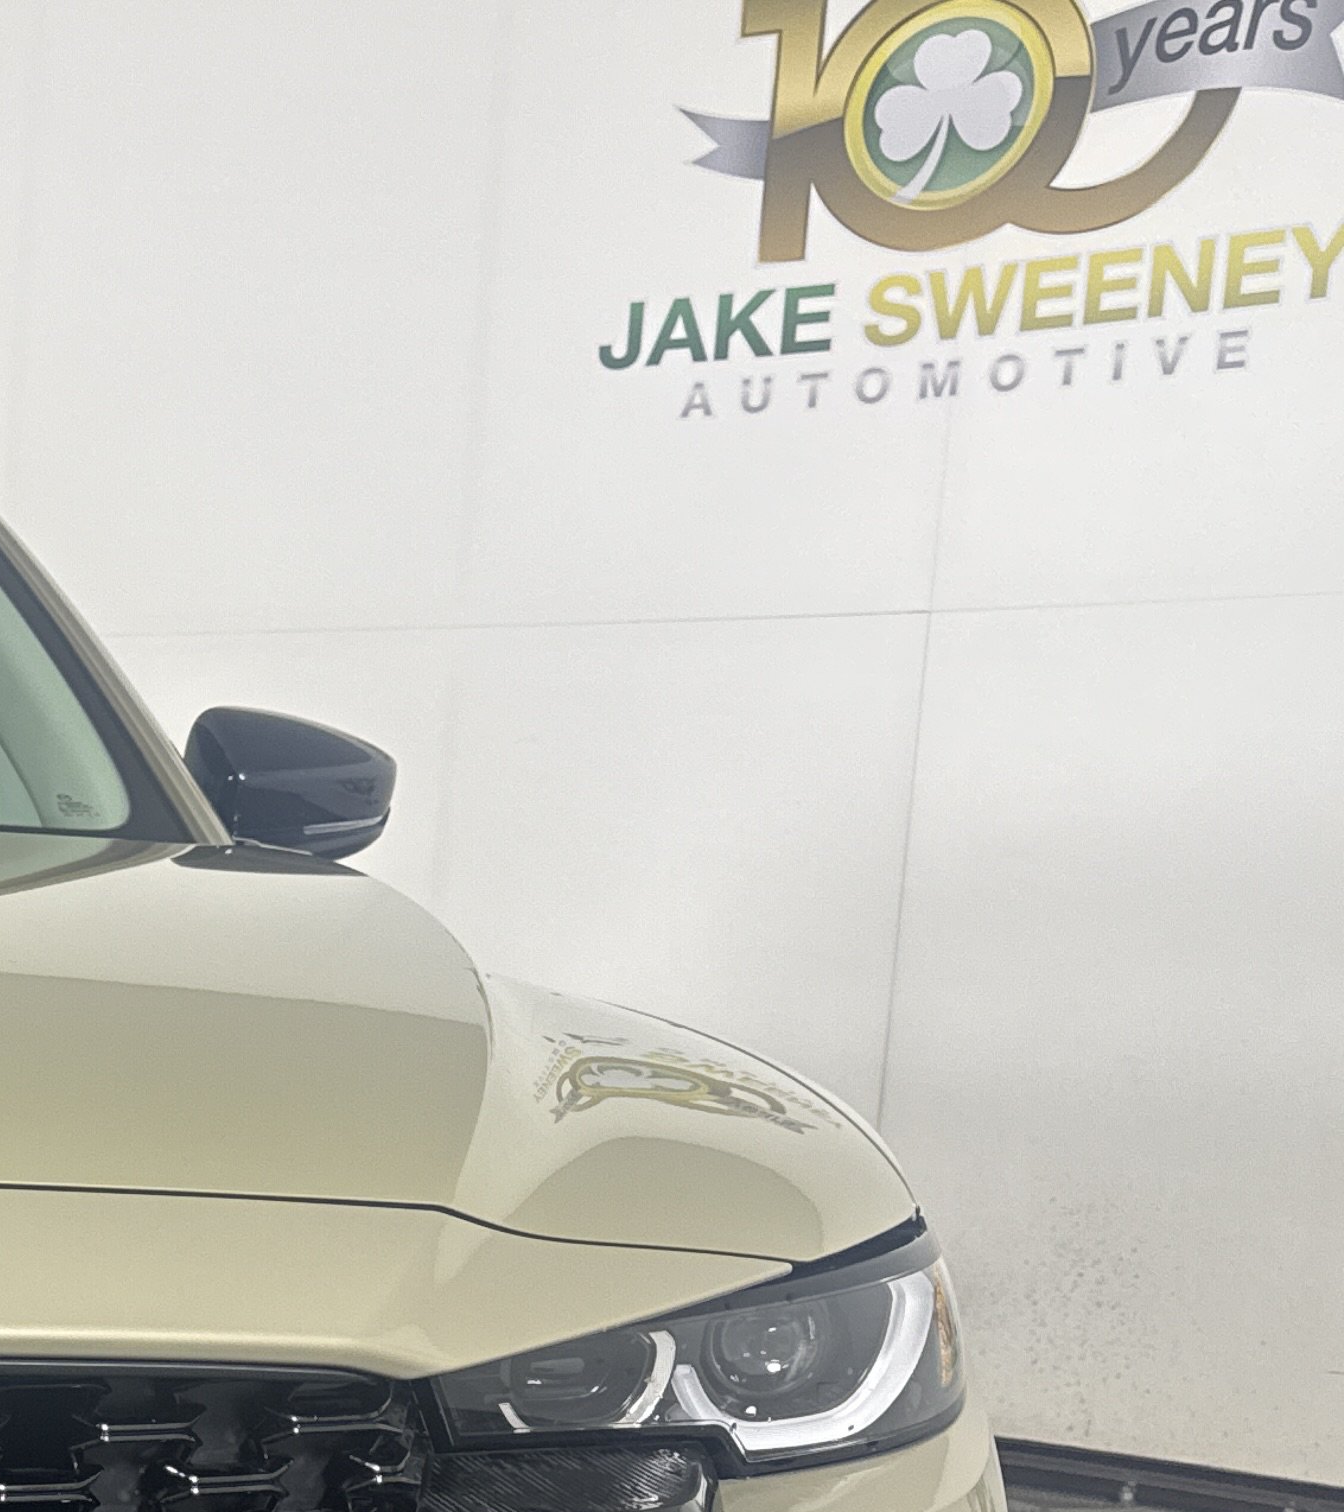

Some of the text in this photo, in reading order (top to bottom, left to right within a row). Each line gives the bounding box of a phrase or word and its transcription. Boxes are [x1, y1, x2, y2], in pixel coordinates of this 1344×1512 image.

[1108, 0, 1318, 95] years
[598, 221, 1344, 370] JAKE SWEENEY
[679, 330, 1250, 419] AUTOMOTIVE
